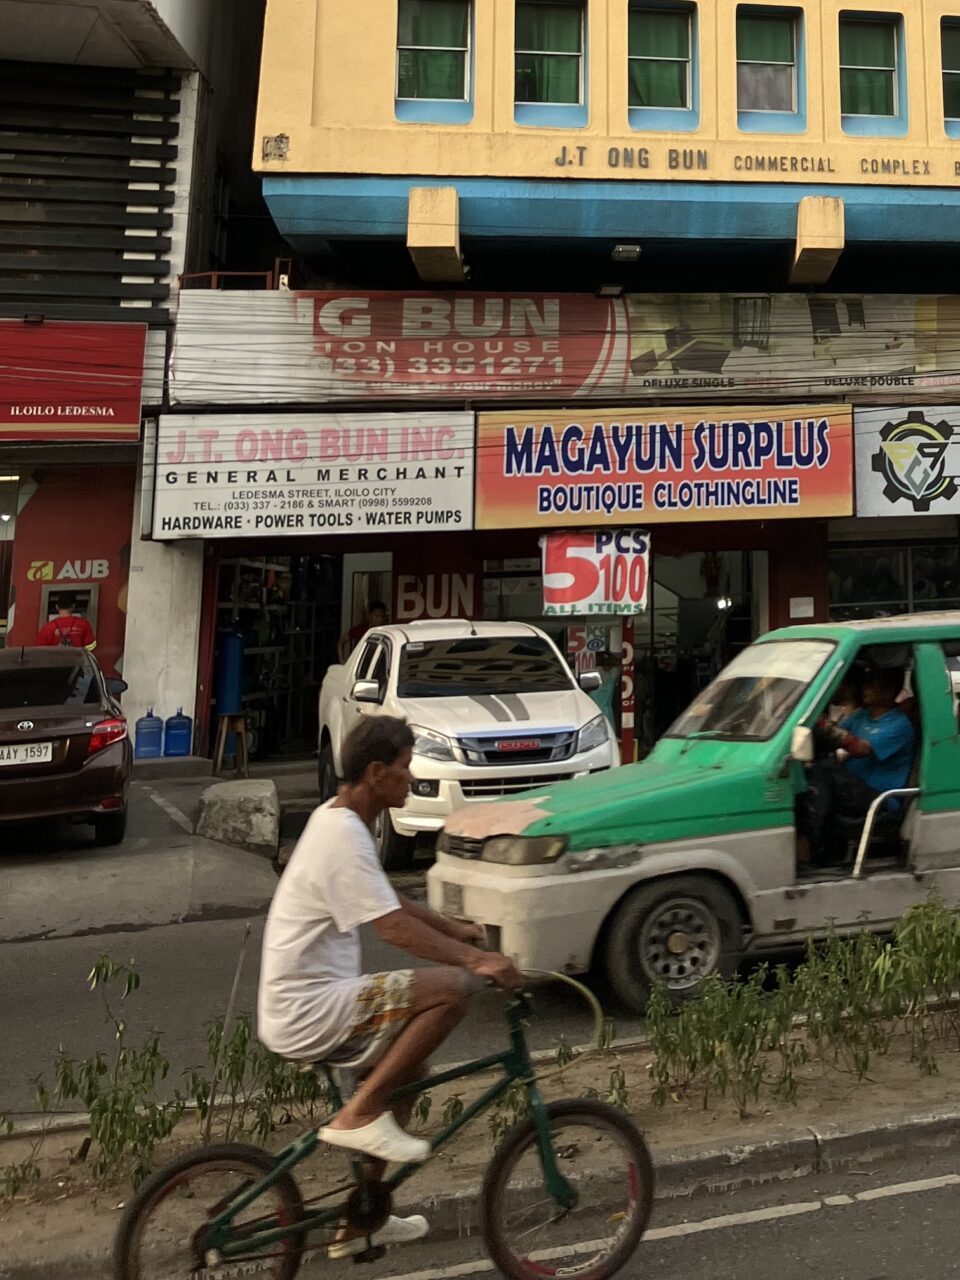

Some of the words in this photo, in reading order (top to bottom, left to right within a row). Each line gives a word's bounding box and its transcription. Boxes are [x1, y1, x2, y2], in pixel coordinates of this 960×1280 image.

[607, 147, 650, 169] ONG
[668, 149, 709, 171] BUN
[734, 156, 836, 173] COMMERCIAL
[860, 159, 931, 176] COMPLEX
[402, 297, 560, 337] BUN
[424, 340, 561, 353] HOUSE
[407, 356, 564, 375] 3351271
[692, 377, 735, 389] SINGLE
[824, 376, 869, 387] DELUXE
[870, 375, 915, 387] DOUBLE
[10, 406, 55, 416] ILOILO
[57, 406, 115, 416] LEDESMA
[166, 430, 223, 464] J.T.
[234, 429, 308, 463] ONG
[319, 428, 389, 462] BUN
[400, 426, 466, 461] INC.
[504, 422, 684, 475] MAGAYUN
[693, 419, 830, 470] SURPLUS
[166, 470, 296, 484] GENERAL
[317, 466, 465, 482] MERCHANT
[232, 489, 285, 500] LEDESMA
[288, 488, 332, 500] STREET,
[334, 488, 371, 498] ILOILO
[373, 487, 397, 497] CITY
[538, 483, 644, 513] BOUTIQUE
[654, 479, 800, 508] CLOTHINGLINE
[224, 501, 249, 511] (033)
[252, 501, 271, 510] 337
[280, 500, 305, 510] 2186
[307, 499, 315, 509] &
[318, 499, 355, 509] SMART
[358, 498, 389, 509] (0998)
[392, 497, 432, 507] 5599208
[162, 516, 243, 531] HARDWARE
[255, 514, 304, 528] POWER
[308, 513, 353, 527] TOOLS
[365, 511, 412, 526] WATER
[416, 510, 462, 524] PUMPS
[595, 530, 648, 555] PCS
[56, 559, 110, 579] AUB
[544, 532, 600, 604] 5
[599, 554, 646, 603] 100
[397, 572, 475, 619] BUN
[545, 604, 581, 615] ALL
[588, 603, 645, 614] ITEMS
[568, 625, 587, 653] 5
[24, 745, 49, 758] 1597
[499, 740, 538, 751] ISUZU
